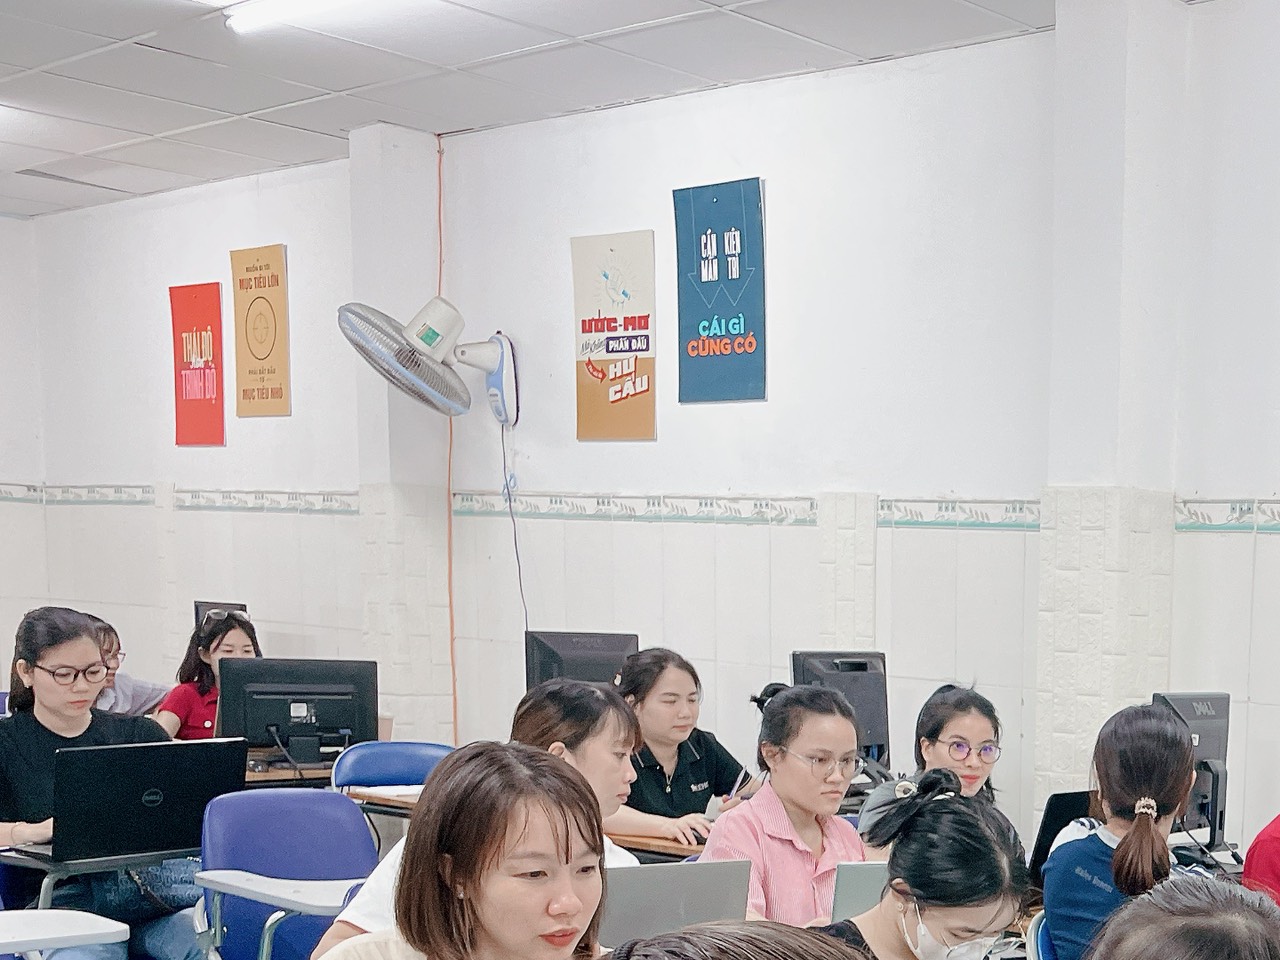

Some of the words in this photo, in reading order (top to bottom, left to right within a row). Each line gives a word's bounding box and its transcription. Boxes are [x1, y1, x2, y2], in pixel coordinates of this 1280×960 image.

[698, 314, 726, 337] CÁI
[728, 312, 745, 335] GÌ
[687, 336, 732, 357] CŨNG
[733, 331, 757, 354] CÓ
